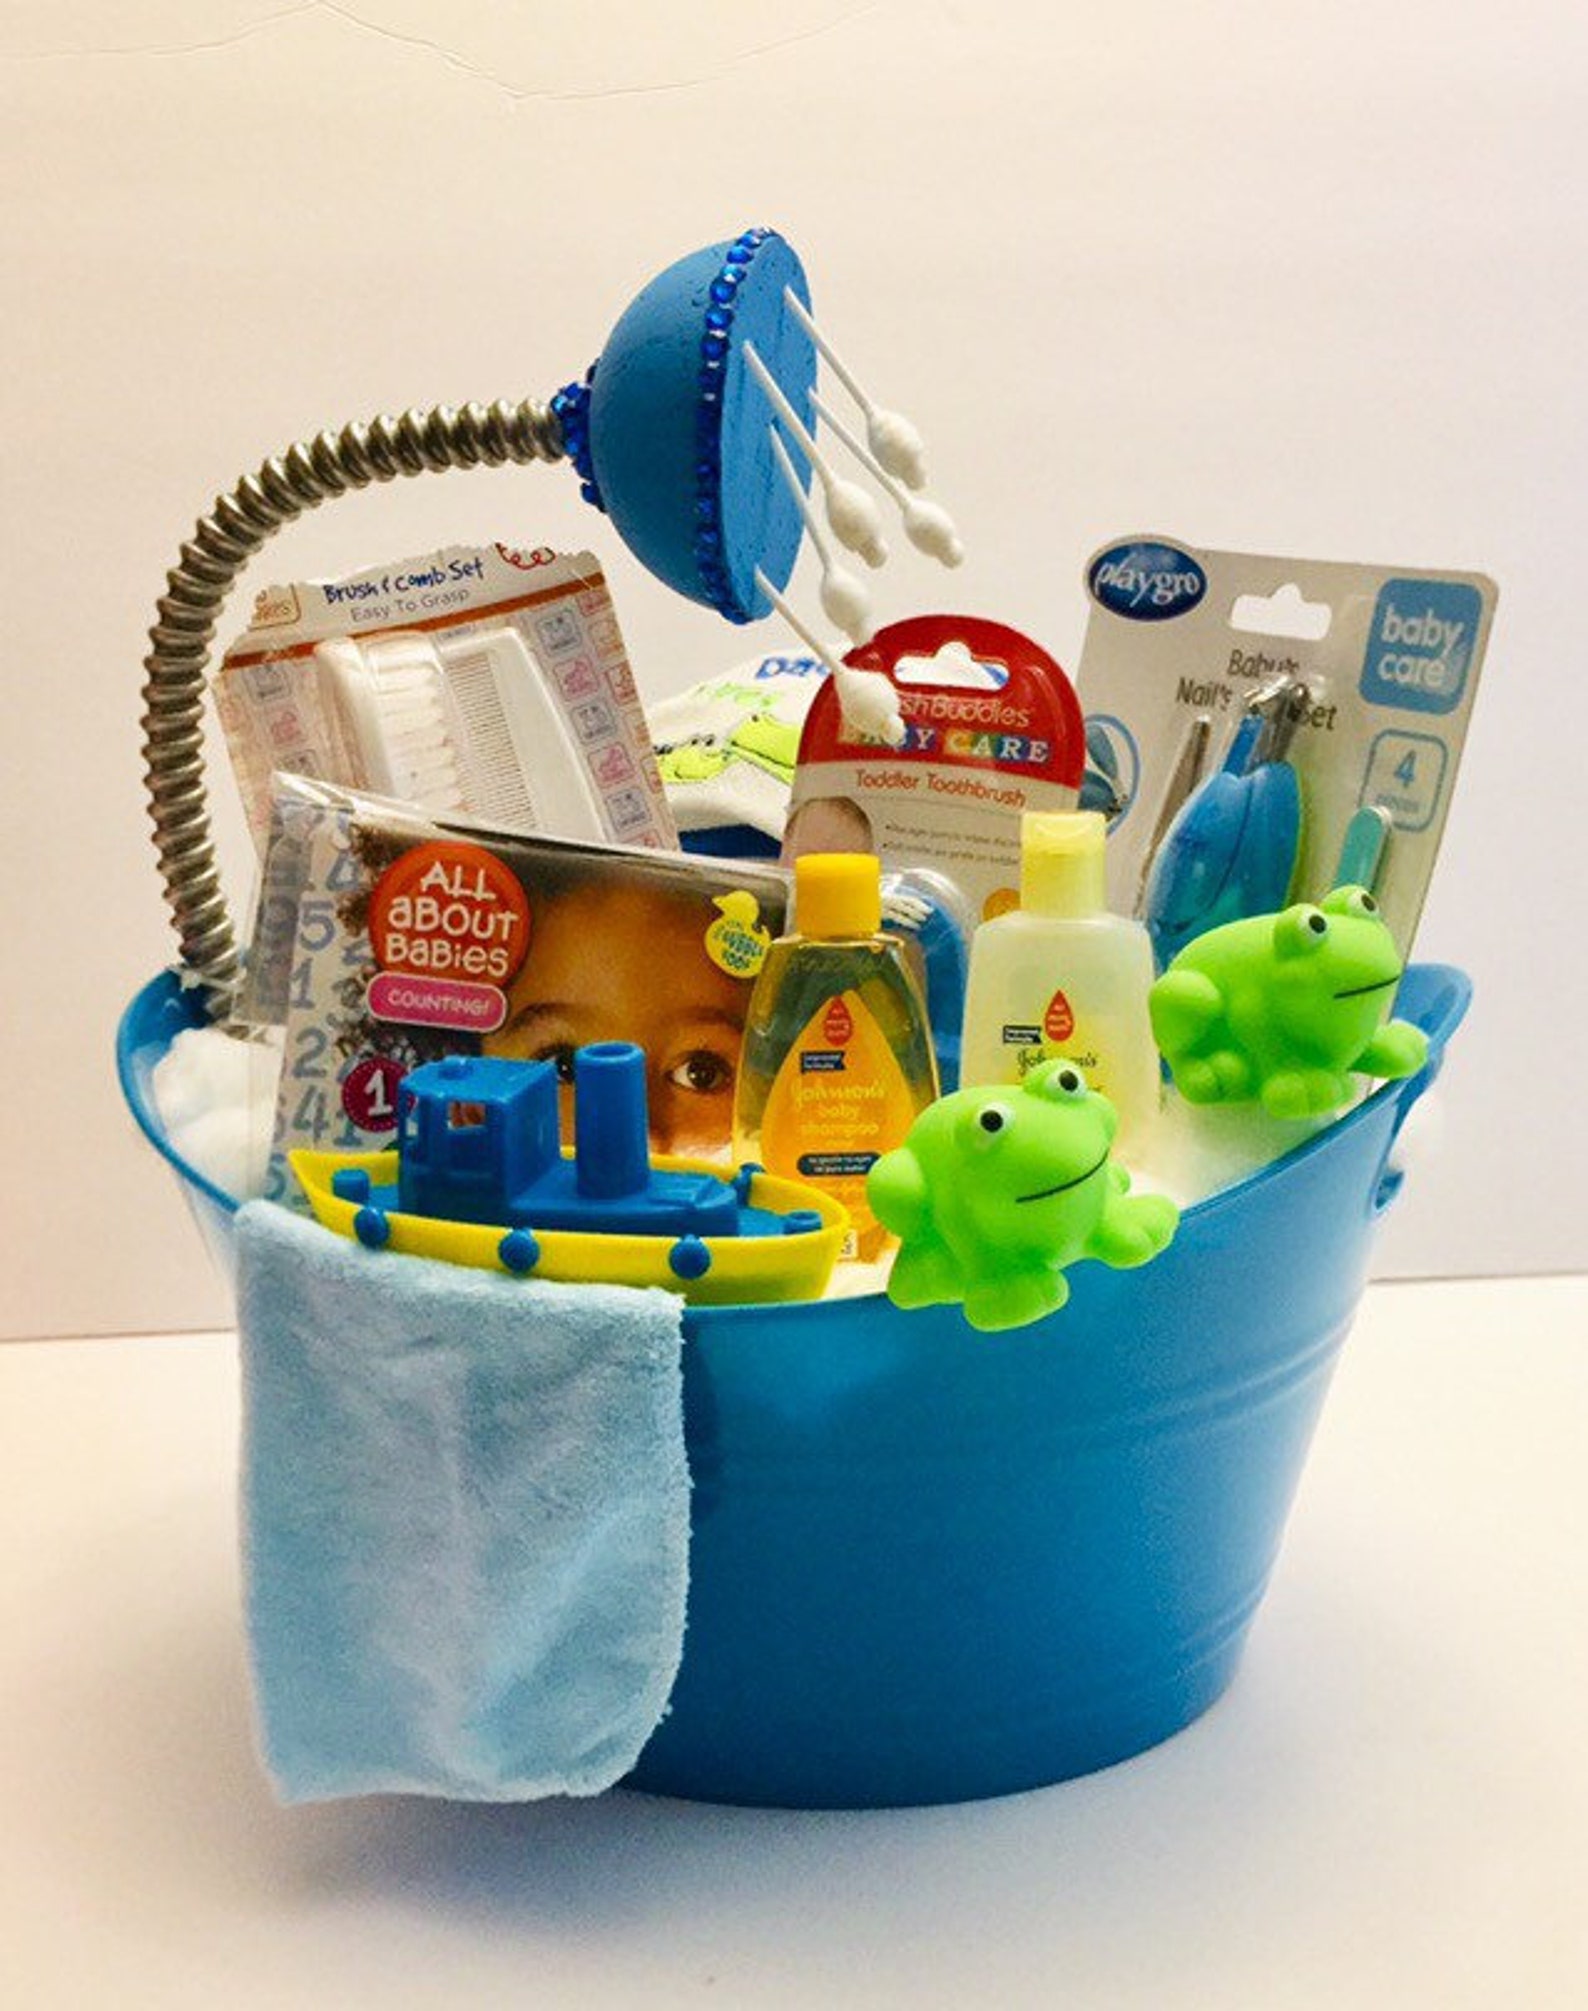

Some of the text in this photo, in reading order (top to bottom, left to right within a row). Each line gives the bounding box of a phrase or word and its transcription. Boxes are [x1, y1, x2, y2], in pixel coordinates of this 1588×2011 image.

[322, 581, 378, 604] Brush
[448, 557, 484, 581] Set
[1094, 551, 1201, 608] playgro
[350, 588, 471, 624] Easy To Grasp
[1381, 602, 1465, 660] baby
[1378, 652, 1447, 690] care
[944, 730, 1050, 764] CARE
[855, 768, 1027, 809] Toddler Toothbrush
[1393, 749, 1417, 790] 4
[419, 860, 497, 901] ALL
[387, 988, 491, 1017] COUNTING!
[363, 1068, 394, 1118] 1
